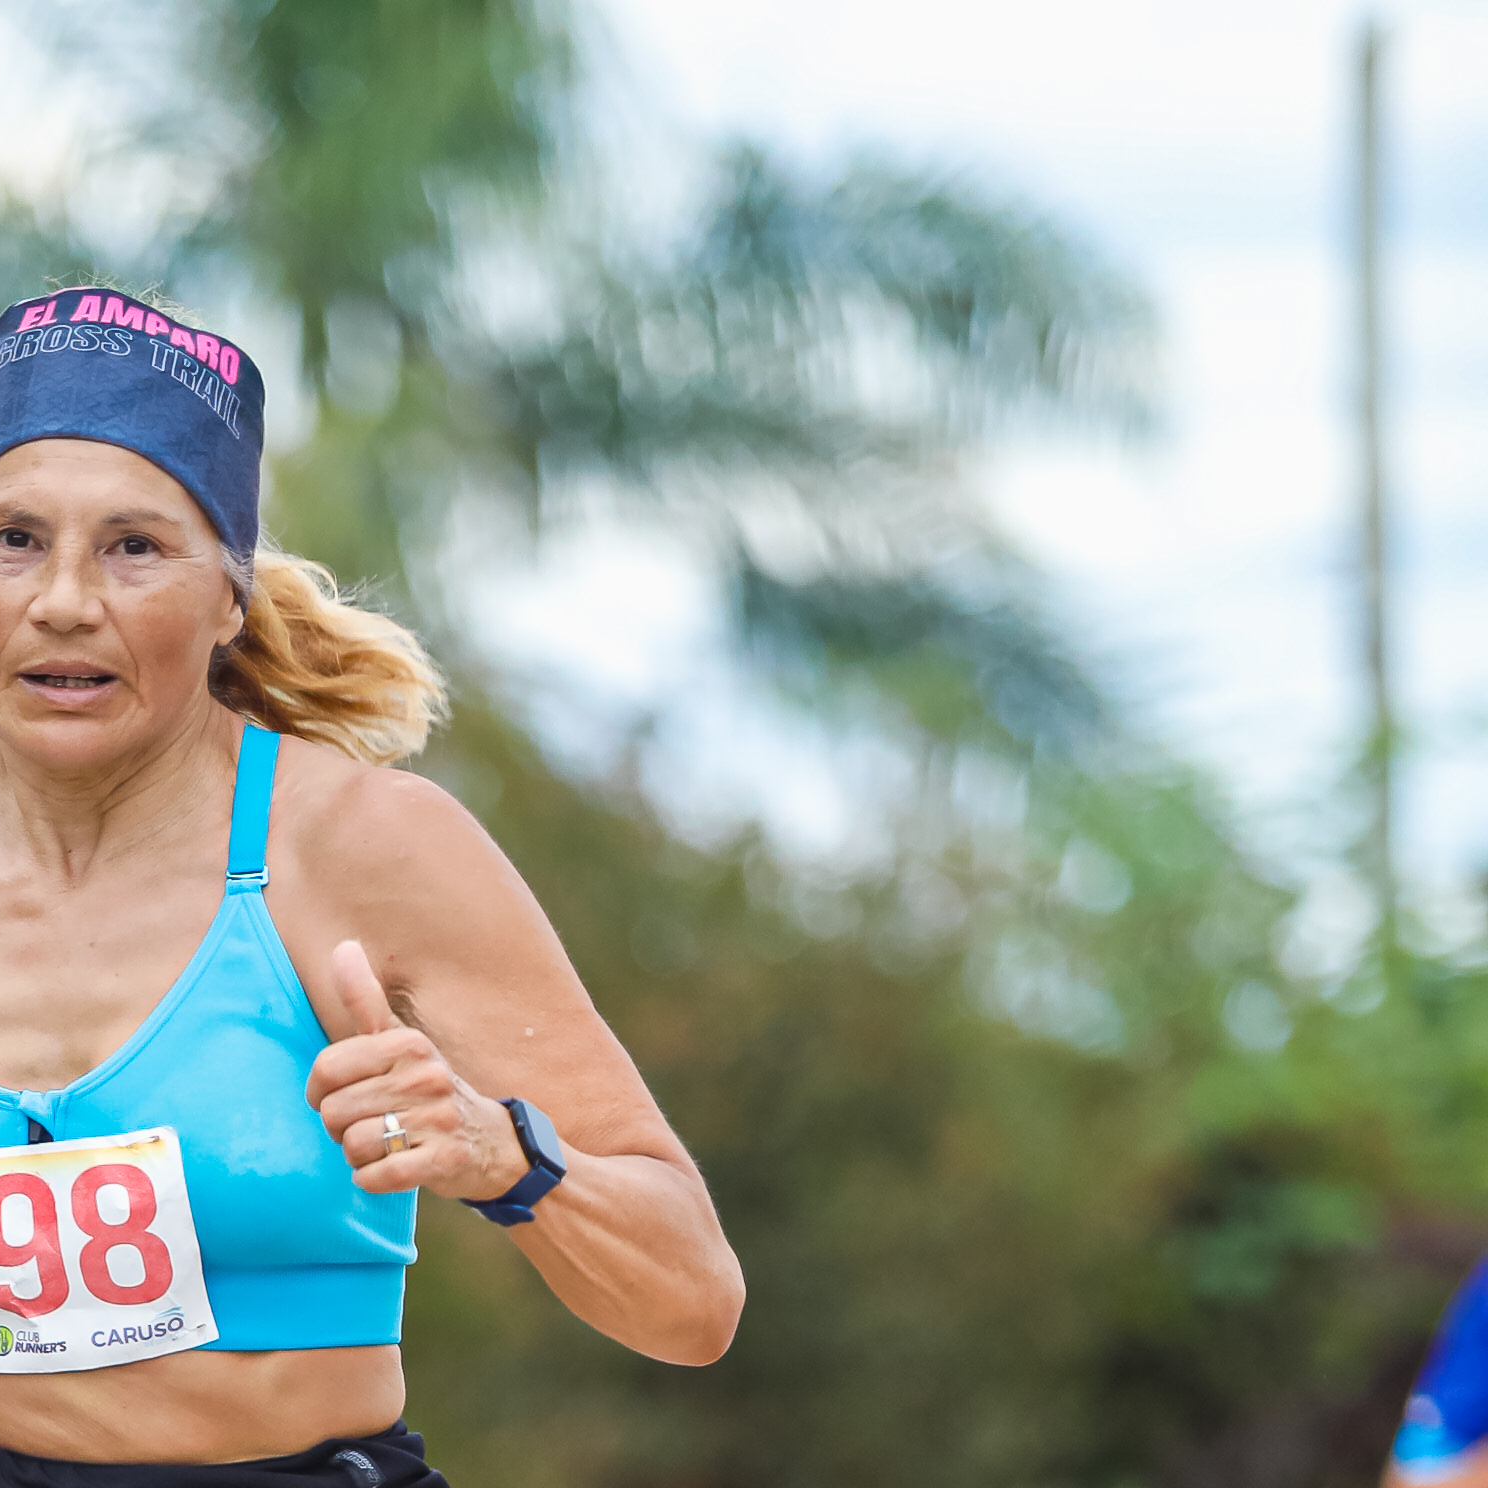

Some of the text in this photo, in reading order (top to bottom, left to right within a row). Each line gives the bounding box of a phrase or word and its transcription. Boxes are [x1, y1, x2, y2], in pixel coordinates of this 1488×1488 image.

[16, 295, 240, 385] EL AMPARO
[149, 339, 240, 440] TRAIL
[16, 1331, 40, 1342] CLUB
[91, 1317, 184, 1347] CARUSO
[15, 1341, 67, 1354] RUNNER'S
